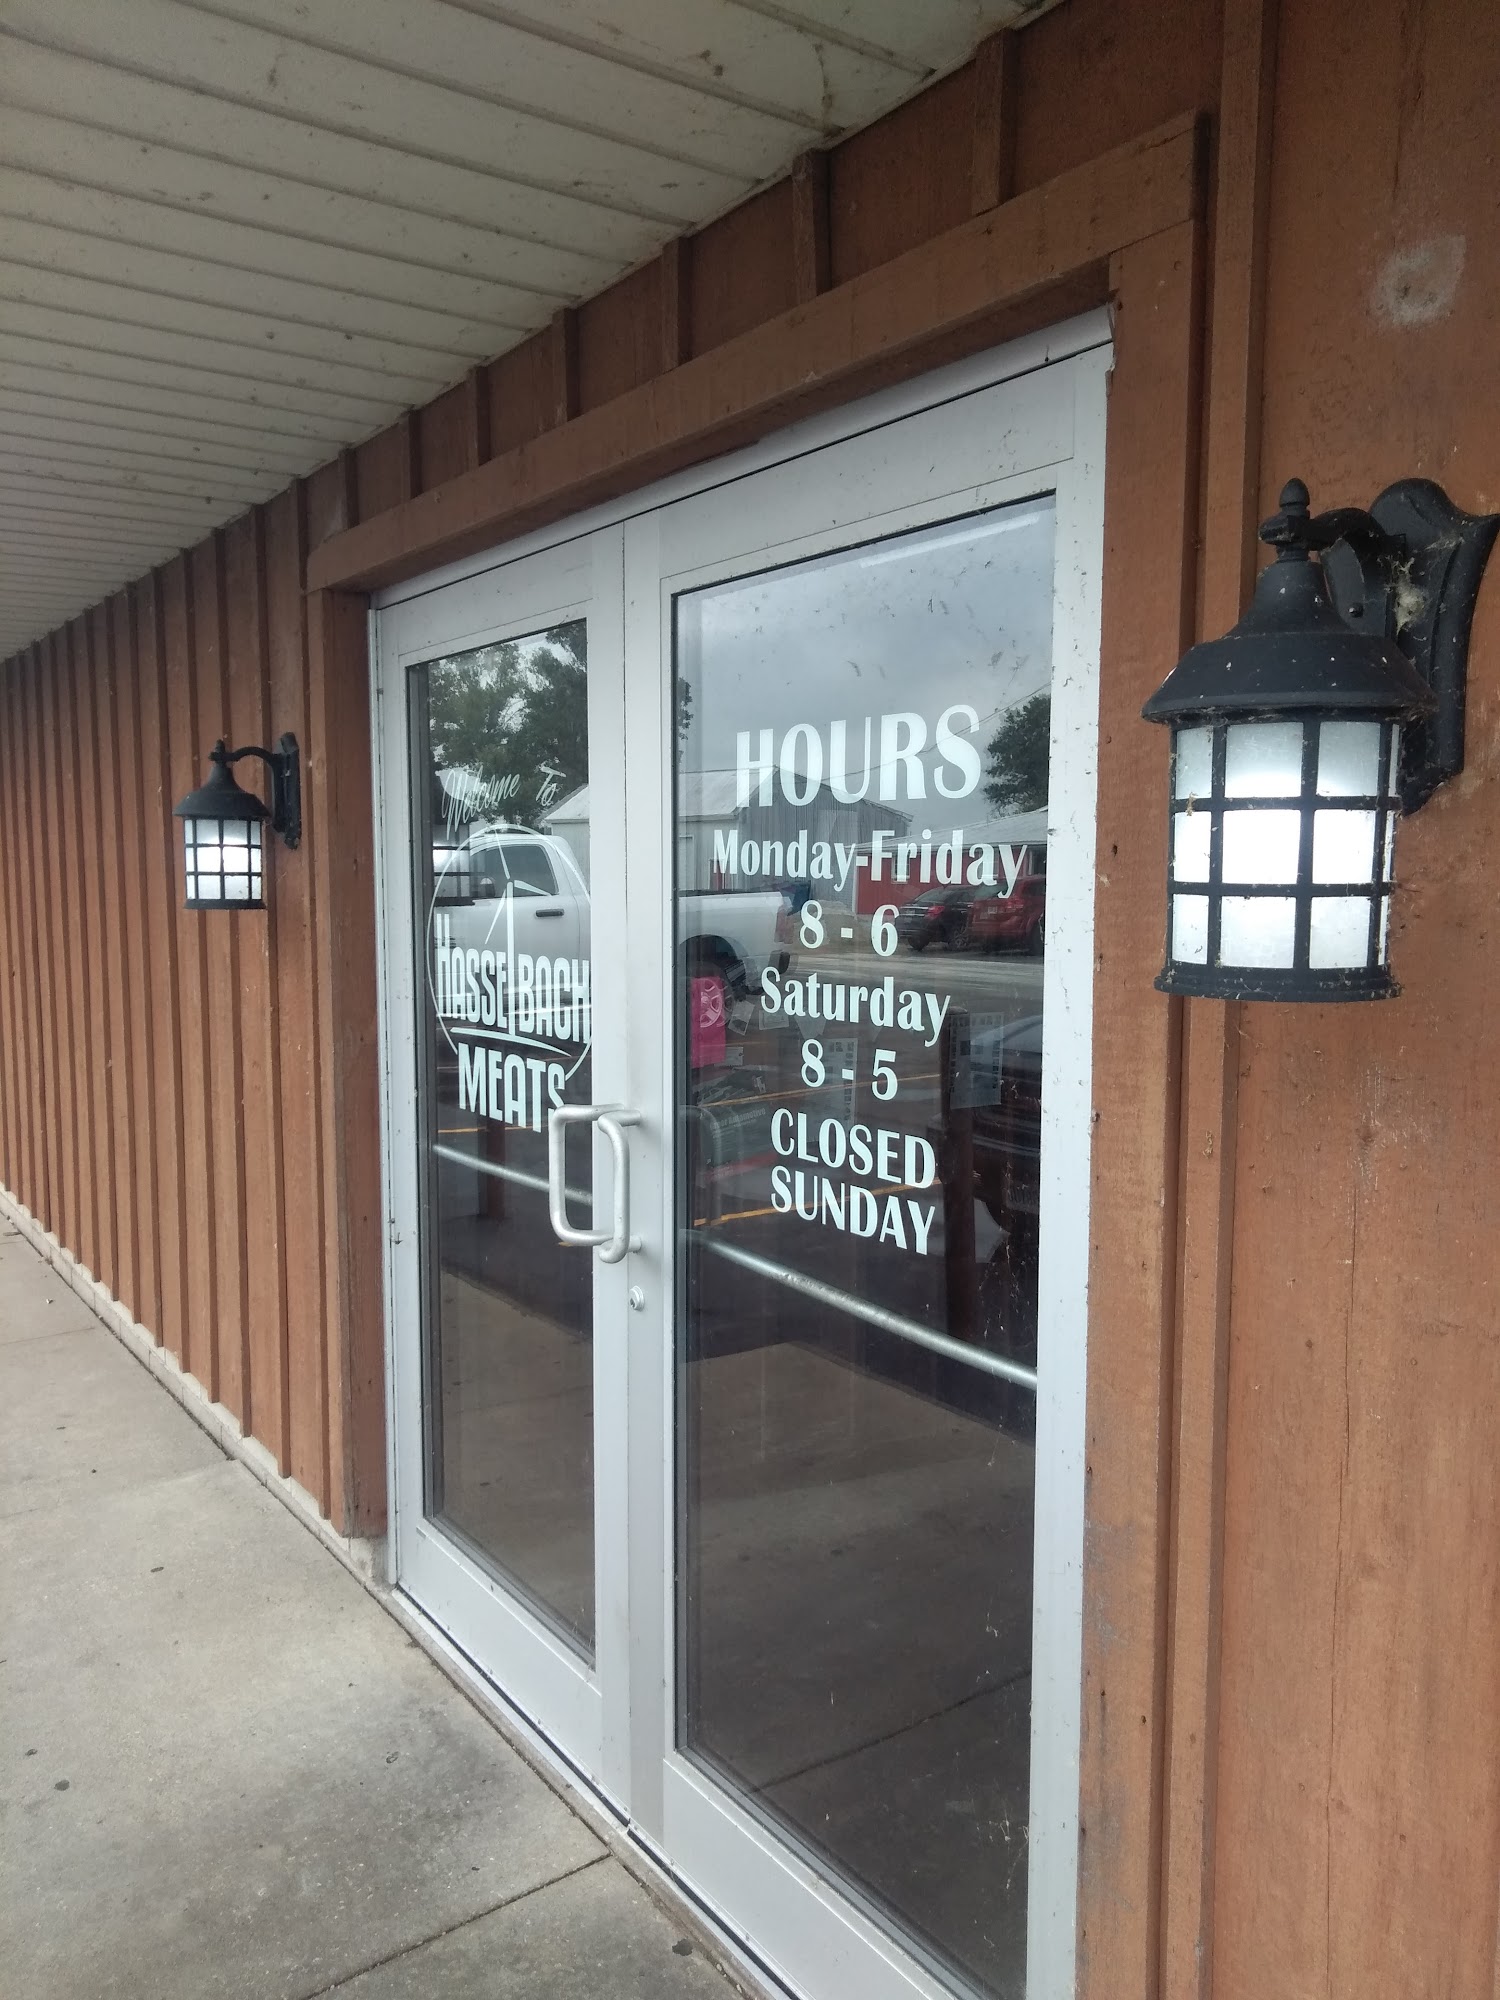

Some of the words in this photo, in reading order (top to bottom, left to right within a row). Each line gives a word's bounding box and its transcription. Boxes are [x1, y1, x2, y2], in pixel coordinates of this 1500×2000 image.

[736, 704, 982, 807] HOURS
[441, 764, 520, 840] Welcome
[535, 766, 567, 807] To
[712, 829, 1028, 899] Monday-Friday
[799, 899, 824, 949] 8
[840, 926, 853, 939] -
[871, 904, 900, 957] 6
[760, 966, 951, 1047] Saturday
[457, 1042, 566, 1133] MEATS
[801, 1038, 826, 1087] 8
[842, 1067, 854, 1081] -
[872, 1048, 898, 1101] 5
[771, 1107, 936, 1189] CLOSED
[771, 1165, 936, 1255] SUNDAY
